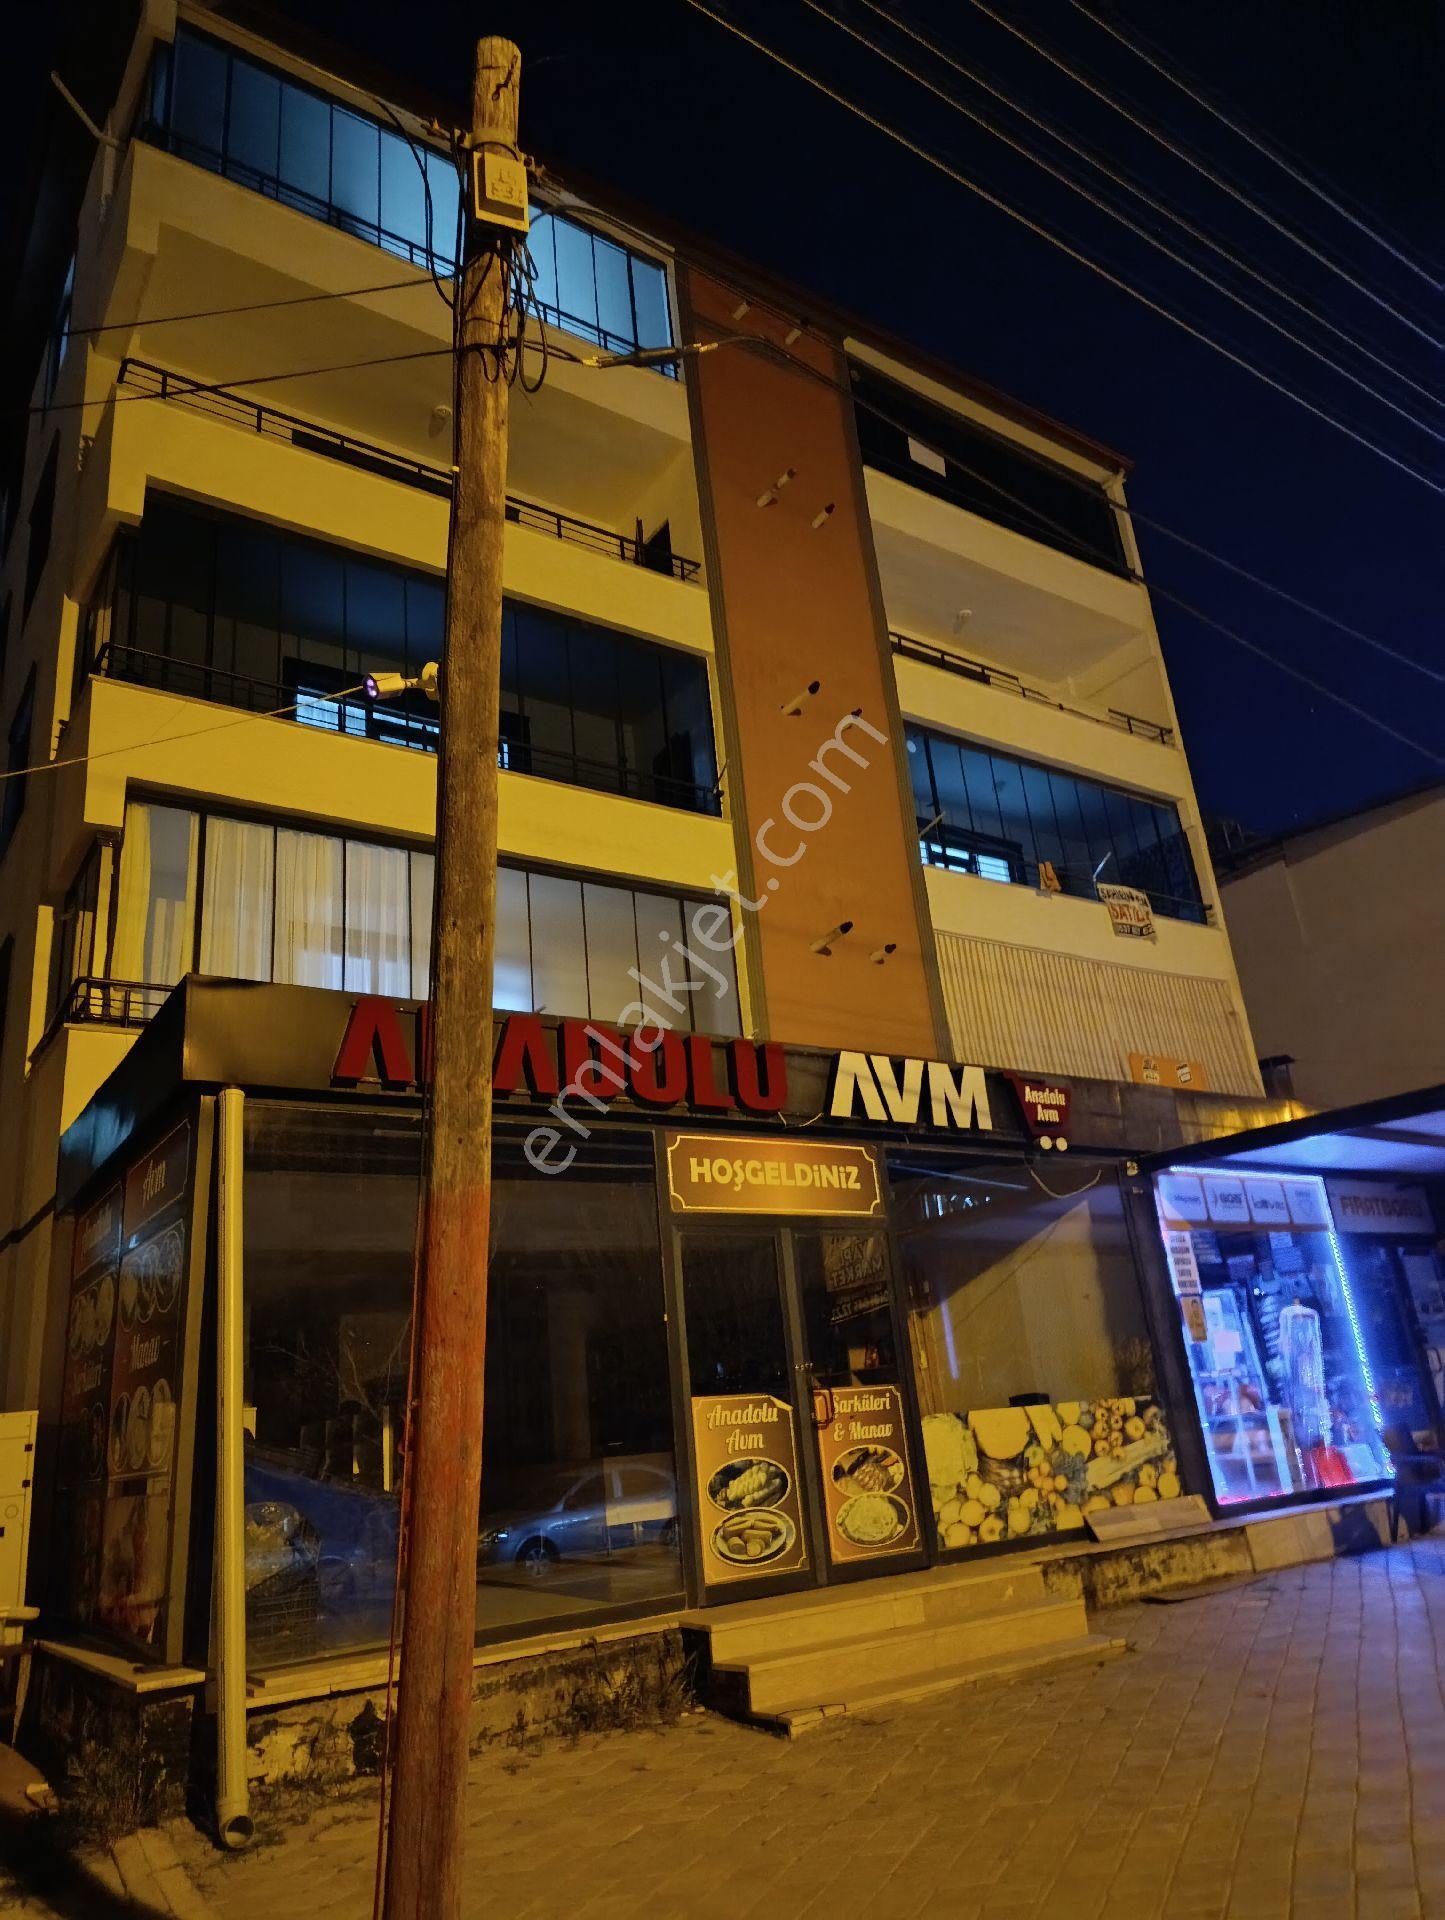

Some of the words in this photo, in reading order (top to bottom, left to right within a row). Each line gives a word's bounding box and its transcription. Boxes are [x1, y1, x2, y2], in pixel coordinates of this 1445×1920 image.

[335, 995, 788, 1111] AADOLU
[831, 1051, 992, 1131] AVM
[1024, 1085, 1066, 1107] Anadolu
[1037, 1104, 1060, 1123] Avm
[706, 1402, 779, 1430] Anadolu
[726, 1428, 764, 1454] Avm
[849, 1421, 893, 1441] Manav
